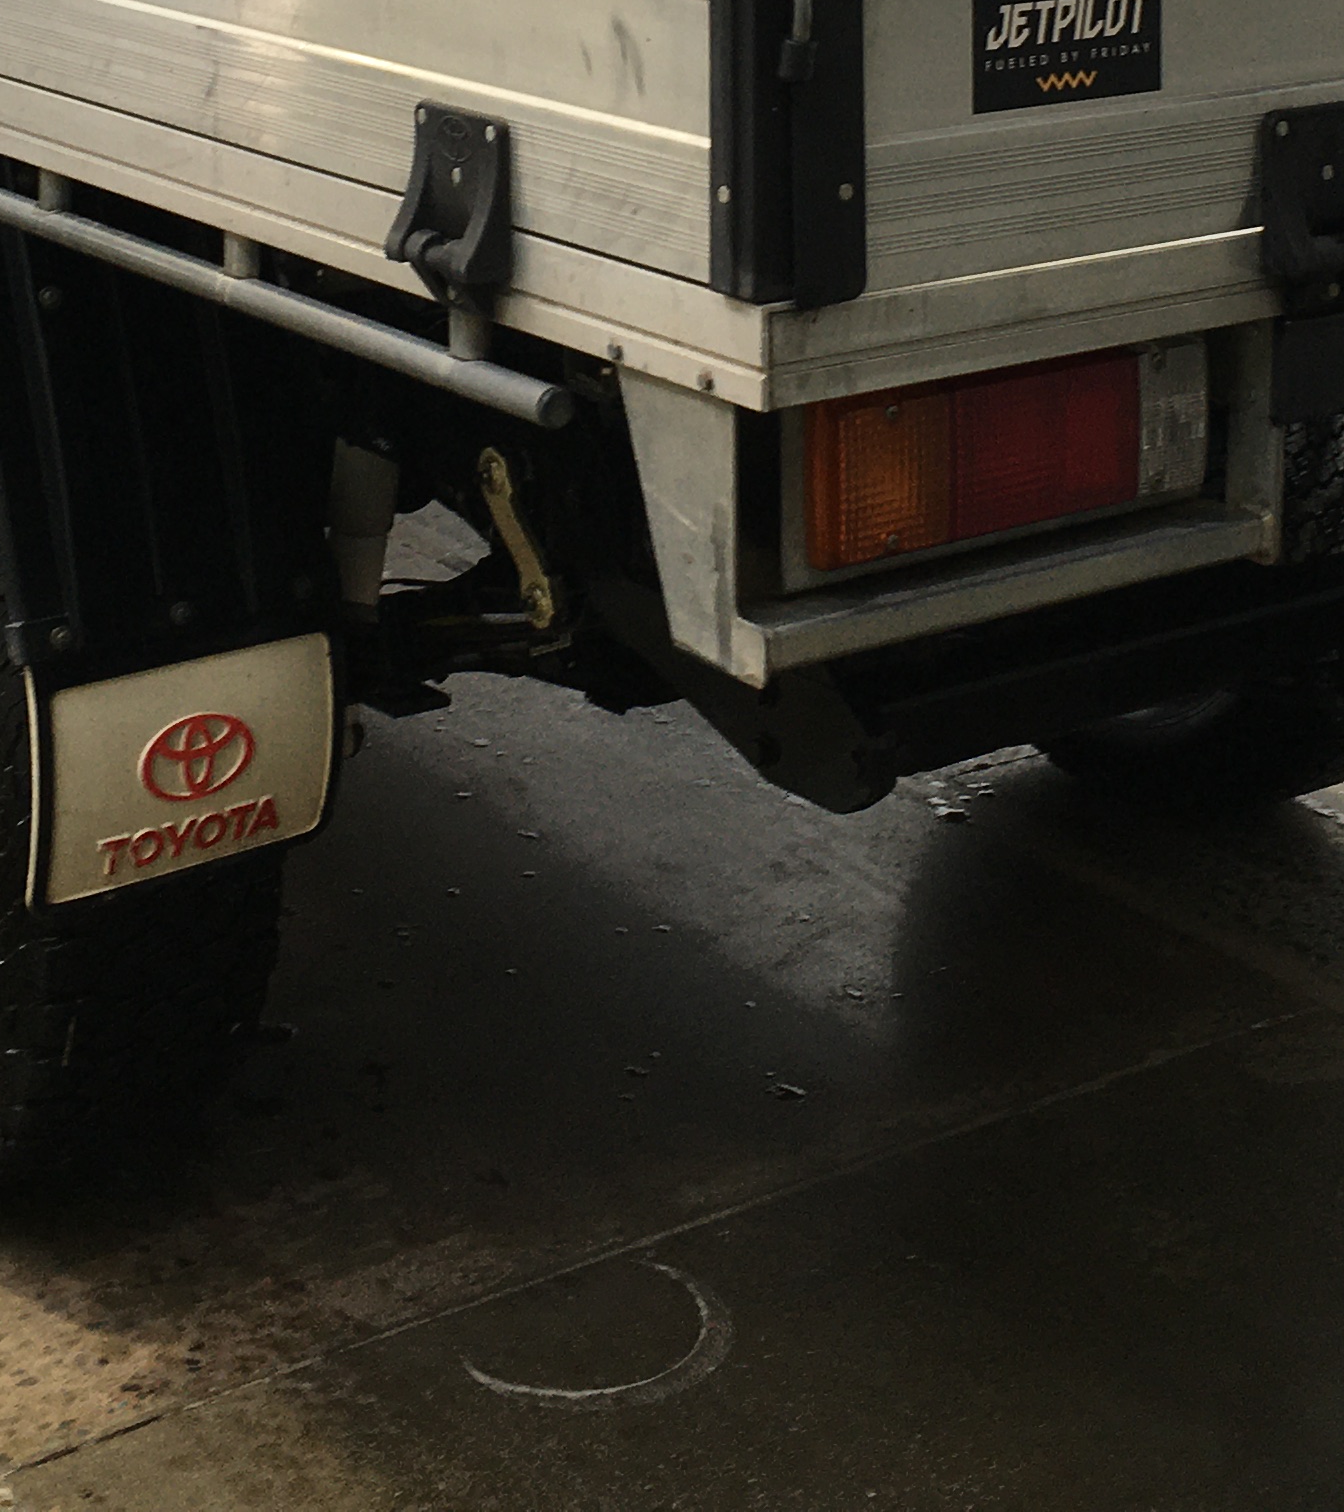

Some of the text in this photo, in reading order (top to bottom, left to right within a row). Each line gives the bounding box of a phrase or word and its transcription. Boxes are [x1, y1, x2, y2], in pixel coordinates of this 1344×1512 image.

[984, 41, 1153, 73] FUELED BY FRIDAY
[96, 793, 280, 876] TOYOTA
